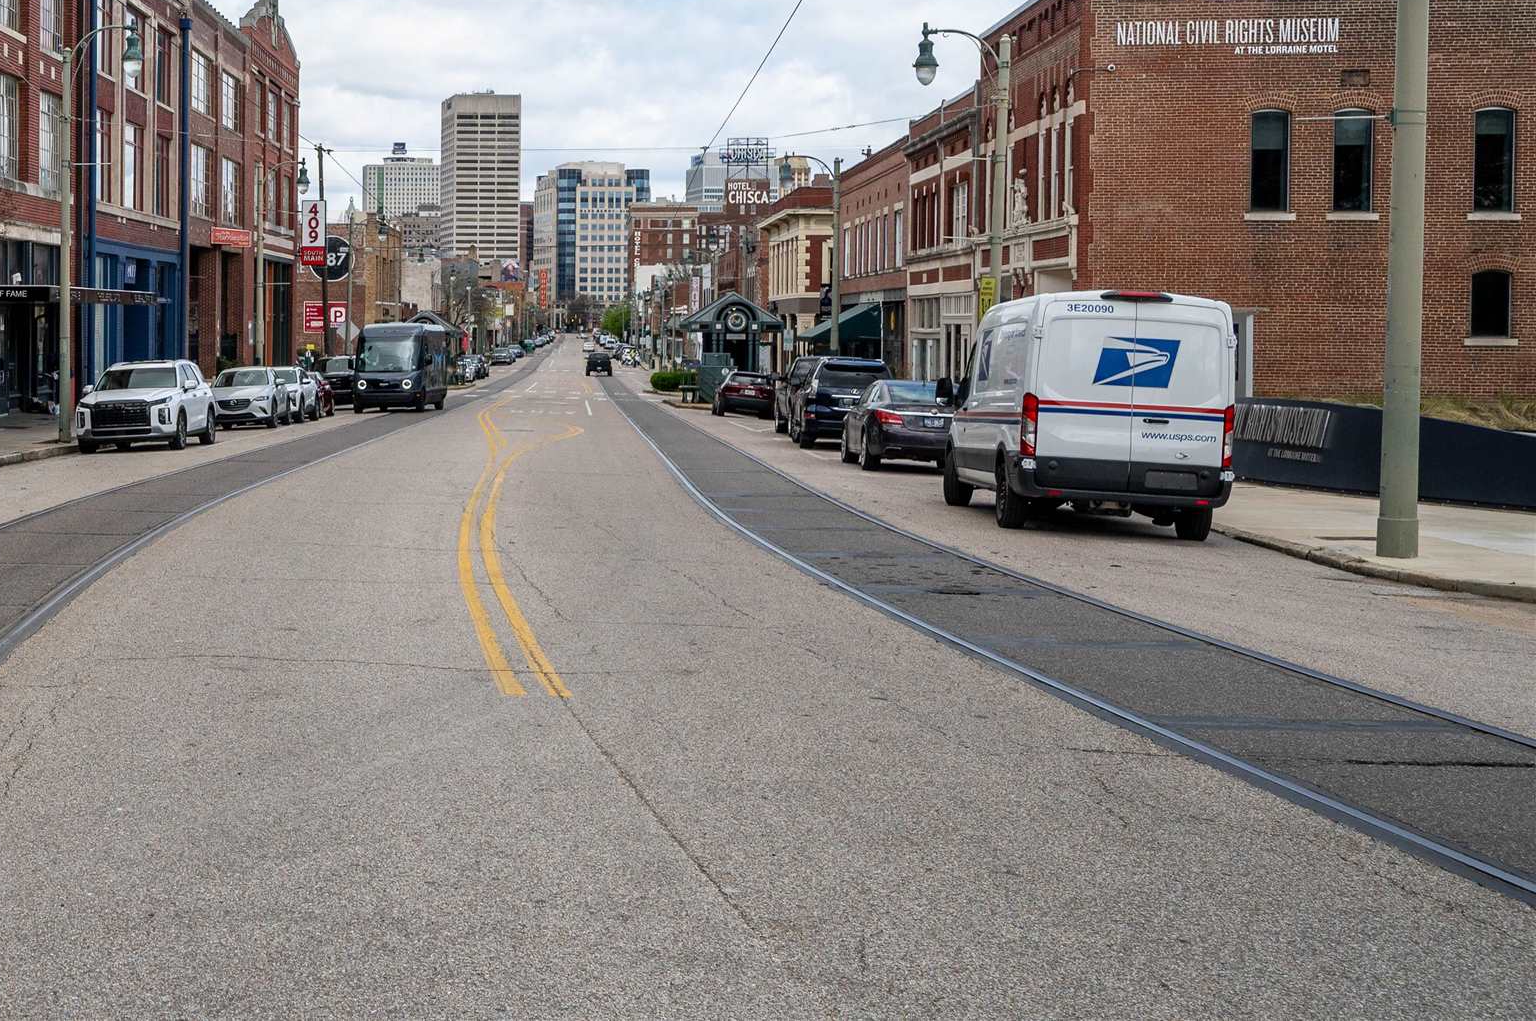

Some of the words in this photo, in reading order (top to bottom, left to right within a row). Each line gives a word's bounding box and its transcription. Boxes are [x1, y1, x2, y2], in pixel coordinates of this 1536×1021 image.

[1116, 20, 1181, 46] NATIONAL
[1186, 19, 1221, 45] CIVIL
[1225, 18, 1274, 44] RIGHTS
[1279, 17, 1339, 43] MUSEUM
[1234, 46, 1246, 55] AT
[1247, 46, 1264, 55] THE
[1265, 45, 1308, 54] LORRAINE
[1309, 44, 1338, 54] MOTEL
[727, 181, 751, 191] HOTEL
[728, 190, 769, 204] CHISCA
[308, 203, 319, 243] 409
[633, 231, 641, 256] HOTEL
[6, 289, 28, 298] FAME
[1066, 303, 1114, 314] 3E20090
[1141, 431, 1217, 443] www.usps.com
